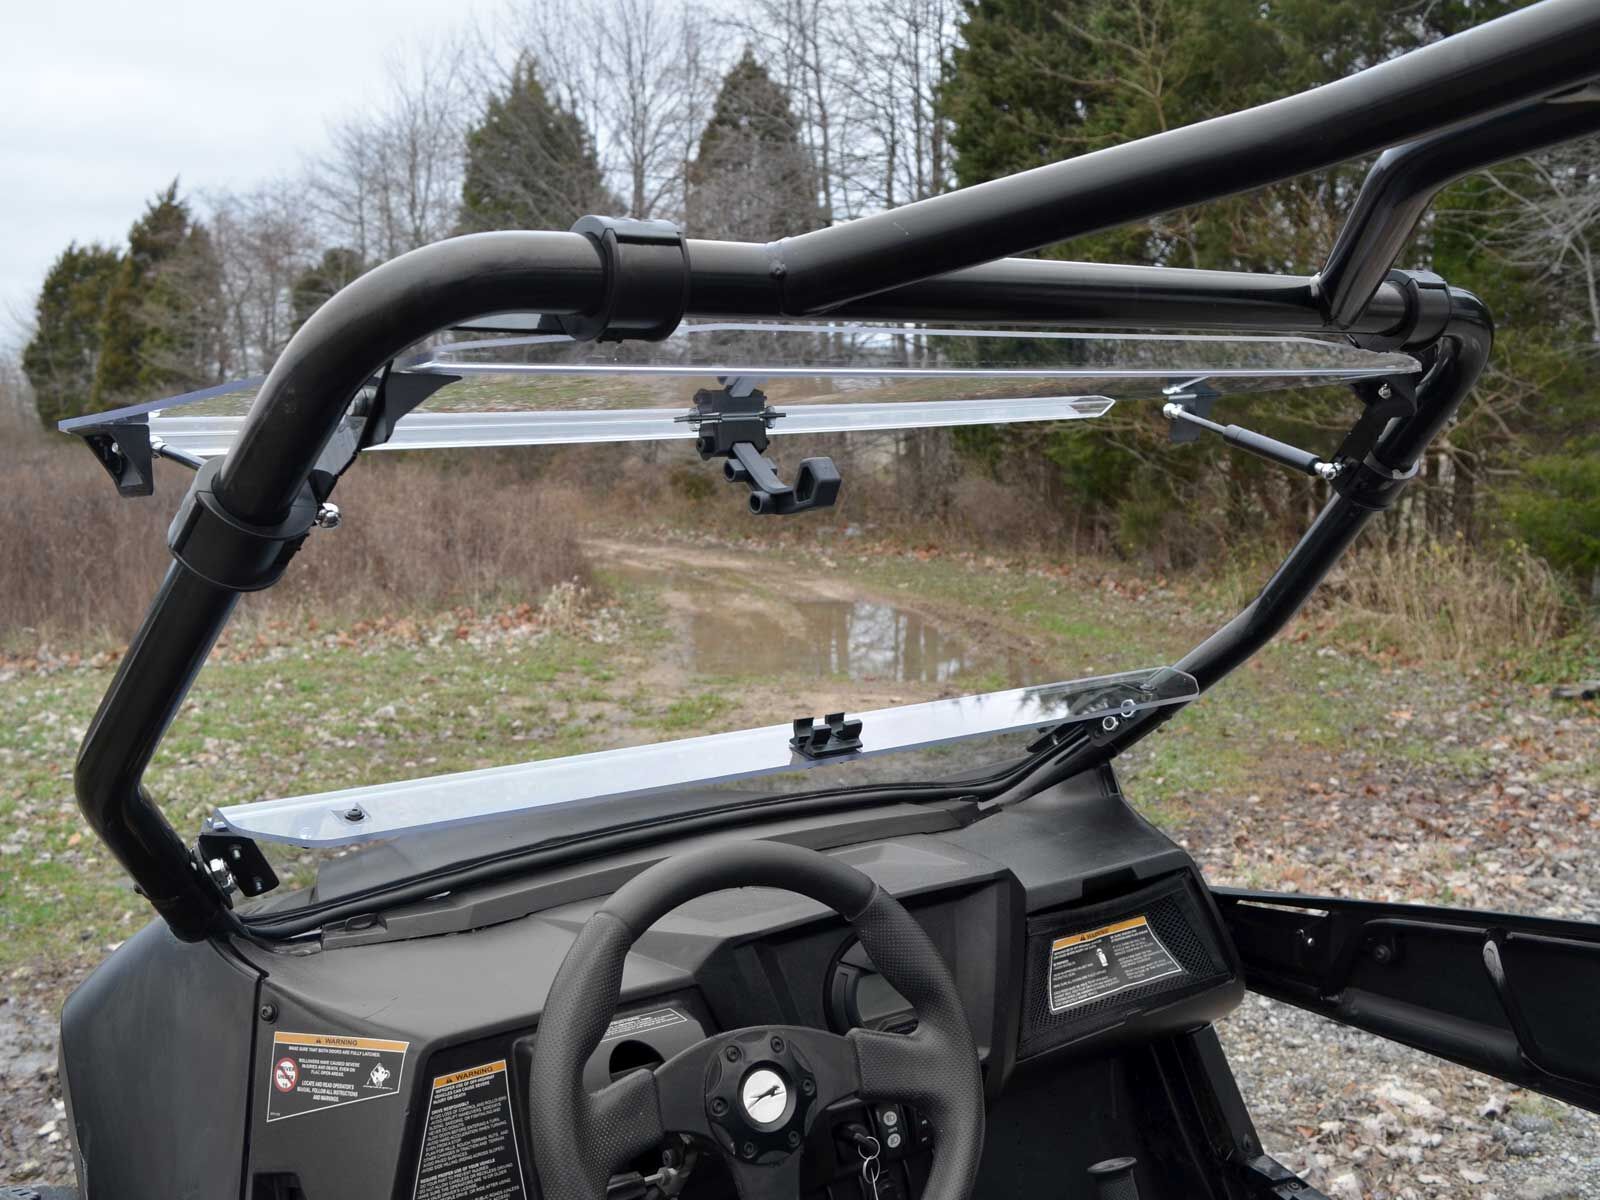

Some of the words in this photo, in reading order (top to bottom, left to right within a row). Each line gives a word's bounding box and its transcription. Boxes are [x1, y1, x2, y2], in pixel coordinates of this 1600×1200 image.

[325, 1038, 357, 1046] WARNING
[456, 1066, 493, 1080] WARNING
[434, 1091, 452, 1099] VEHICLES
